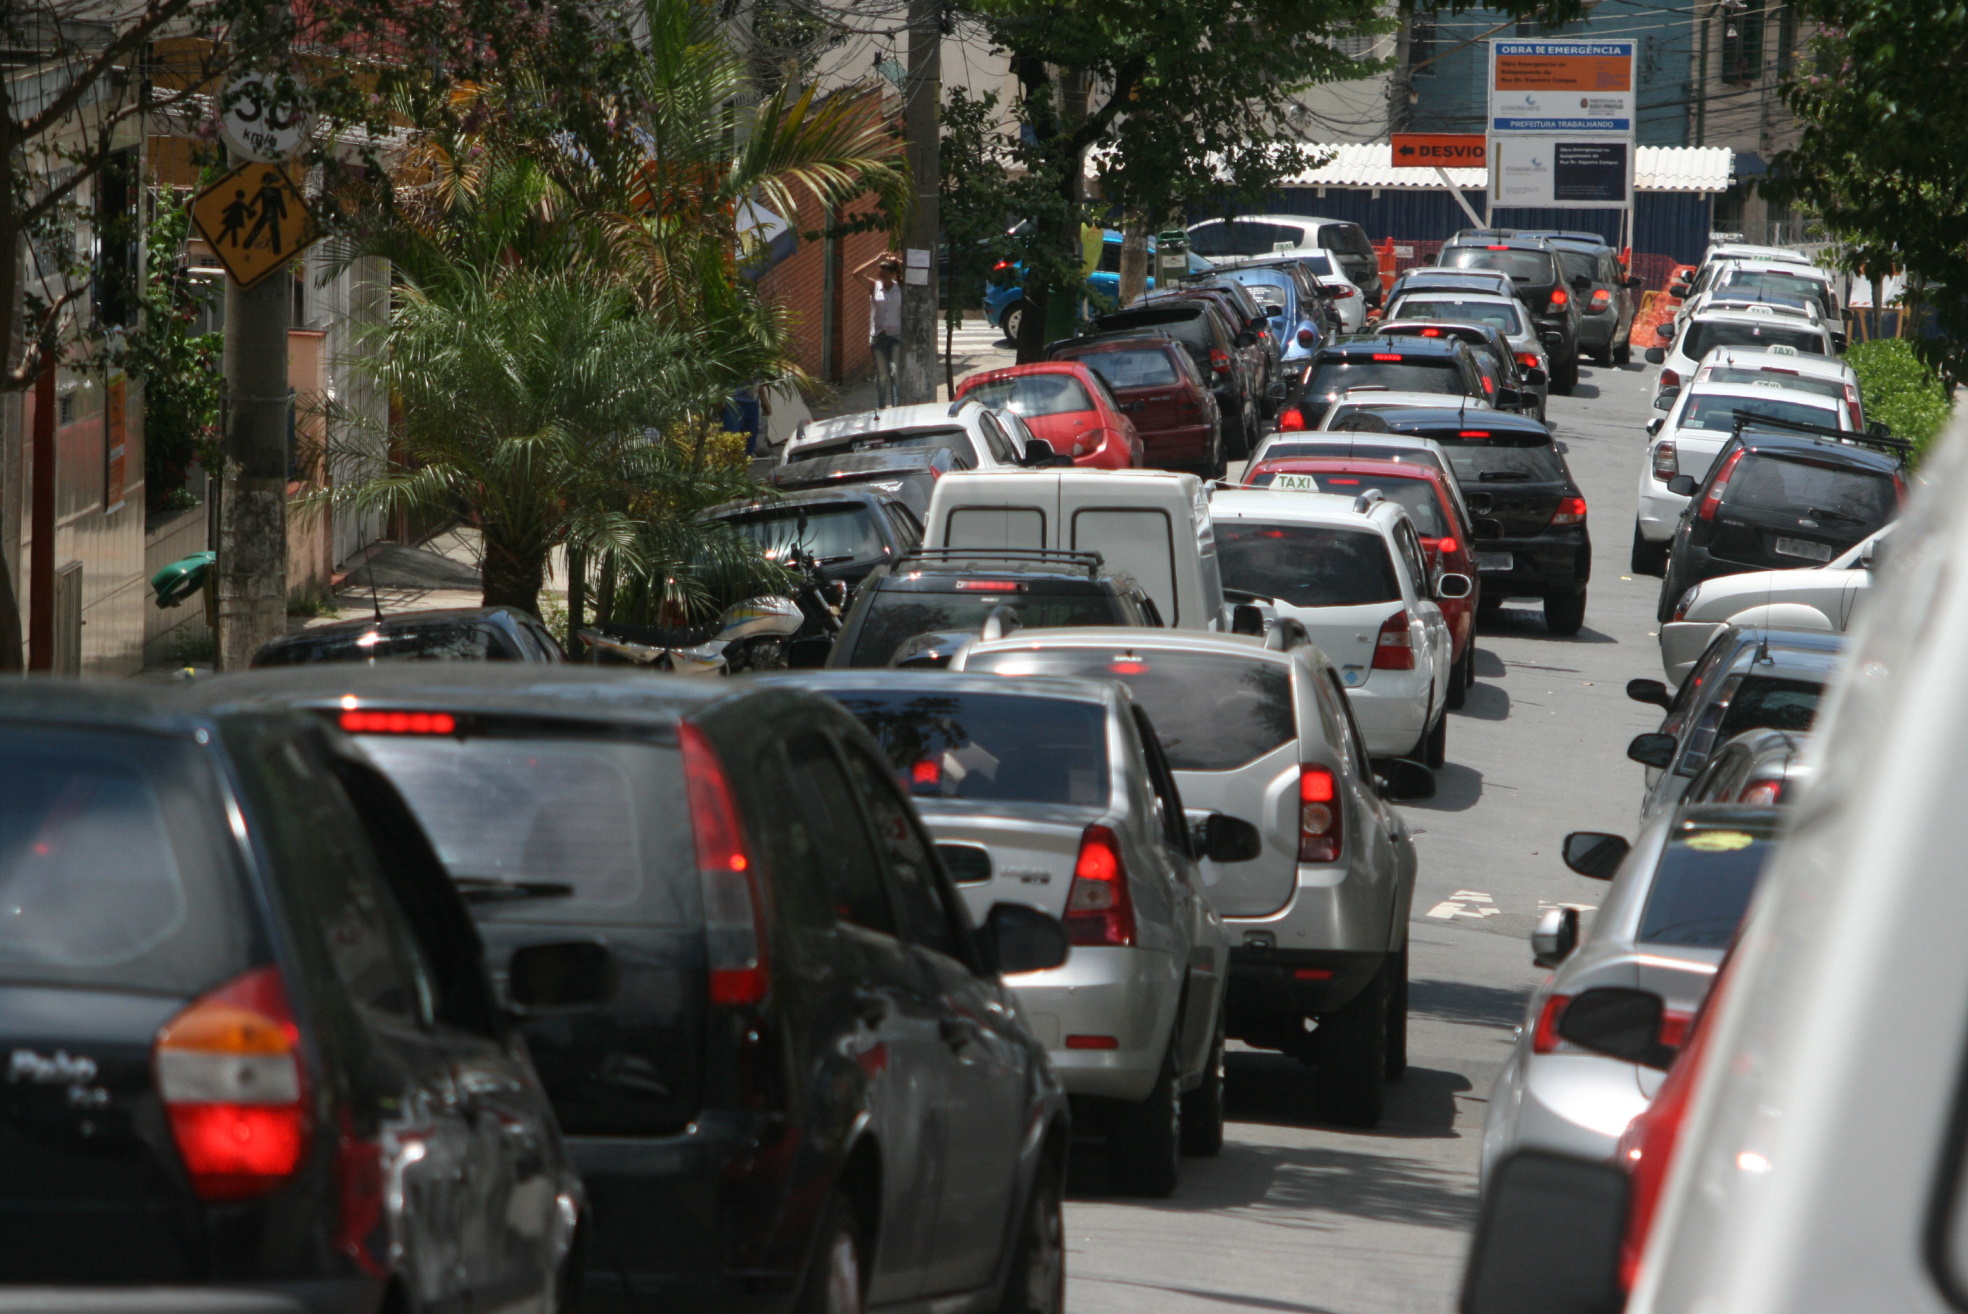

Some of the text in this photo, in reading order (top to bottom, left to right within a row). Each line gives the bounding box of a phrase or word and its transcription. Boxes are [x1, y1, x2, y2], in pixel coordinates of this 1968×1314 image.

[1501, 44, 1622, 54] OBRA DE EMERGÊNCIA
[1510, 120, 1556, 128] PREFEITURA
[1419, 145, 1485, 157] DESVIO
[1773, 346, 1794, 356] TAXI
[1279, 475, 1311, 489] TAXI
